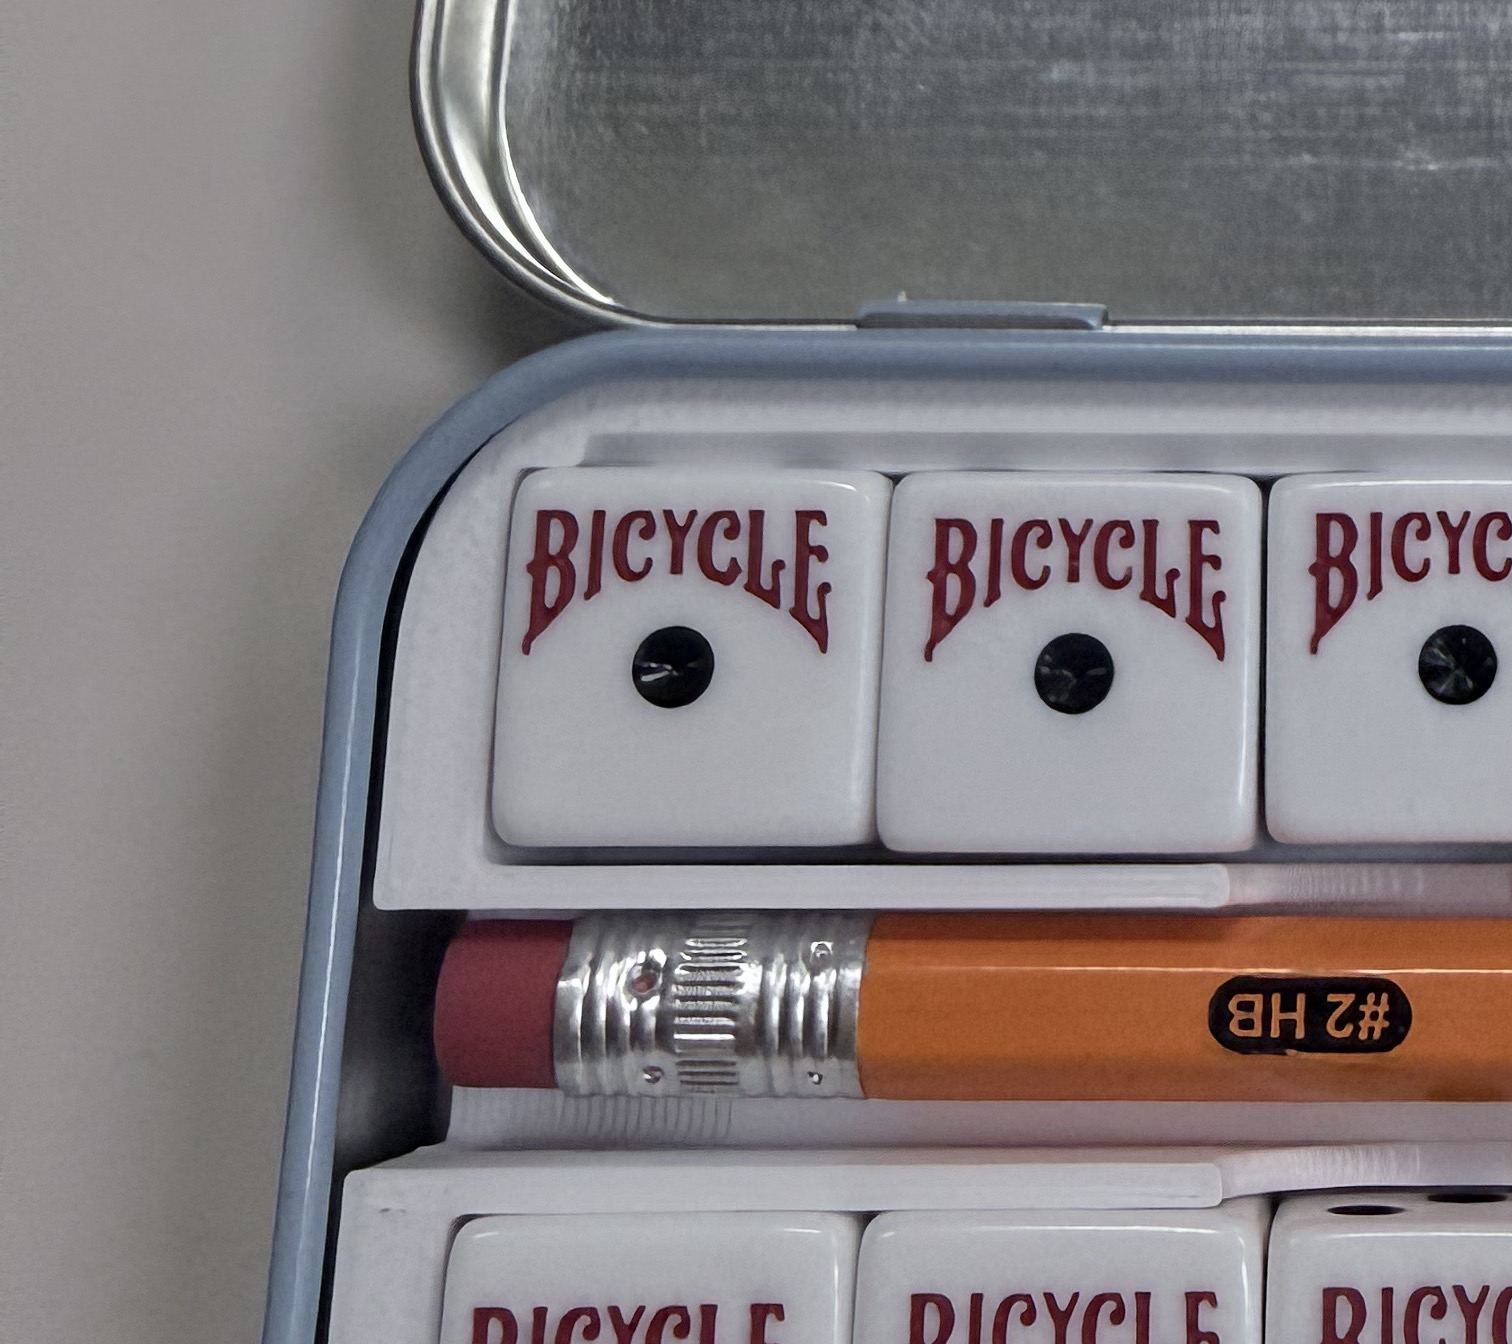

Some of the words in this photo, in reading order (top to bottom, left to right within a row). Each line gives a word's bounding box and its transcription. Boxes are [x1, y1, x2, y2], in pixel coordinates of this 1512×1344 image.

[522, 510, 829, 653] BICYCLE
[924, 518, 1226, 661] BICYCLE
[1224, 990, 1305, 1040] HB
[1325, 991, 1391, 1042] #2
